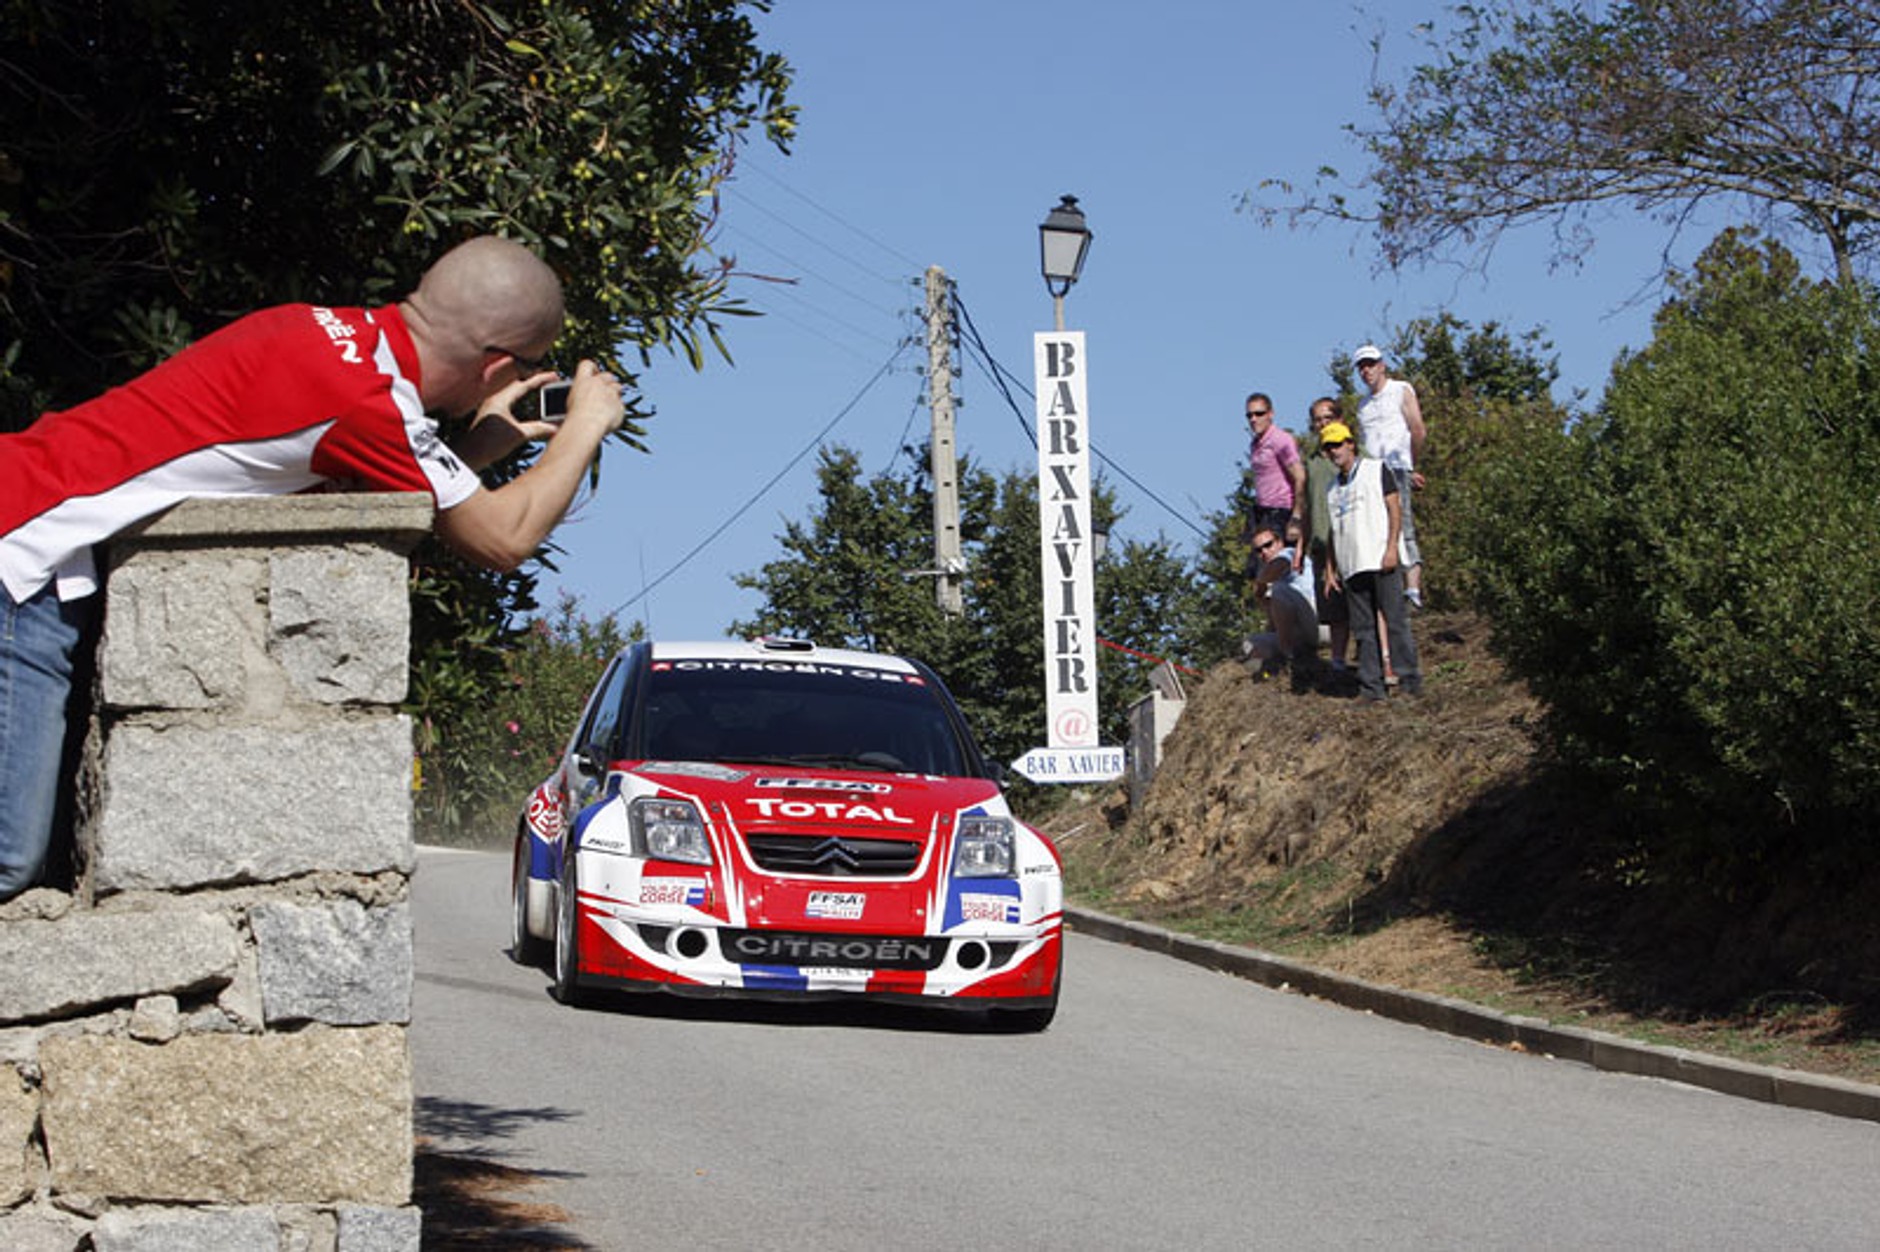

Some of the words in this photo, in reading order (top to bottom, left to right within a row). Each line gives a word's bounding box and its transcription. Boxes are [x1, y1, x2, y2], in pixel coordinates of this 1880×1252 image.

[1044, 342, 1080, 455] BAR
[1049, 465, 1089, 693] XAVIER
[1026, 755, 1057, 774] BAR
[1068, 754, 1121, 775] XAVIER
[745, 798, 914, 823] TOTAL
[639, 892, 685, 904] CORSE
[810, 892, 858, 905] FFSA
[735, 935, 931, 961] CITROËN
